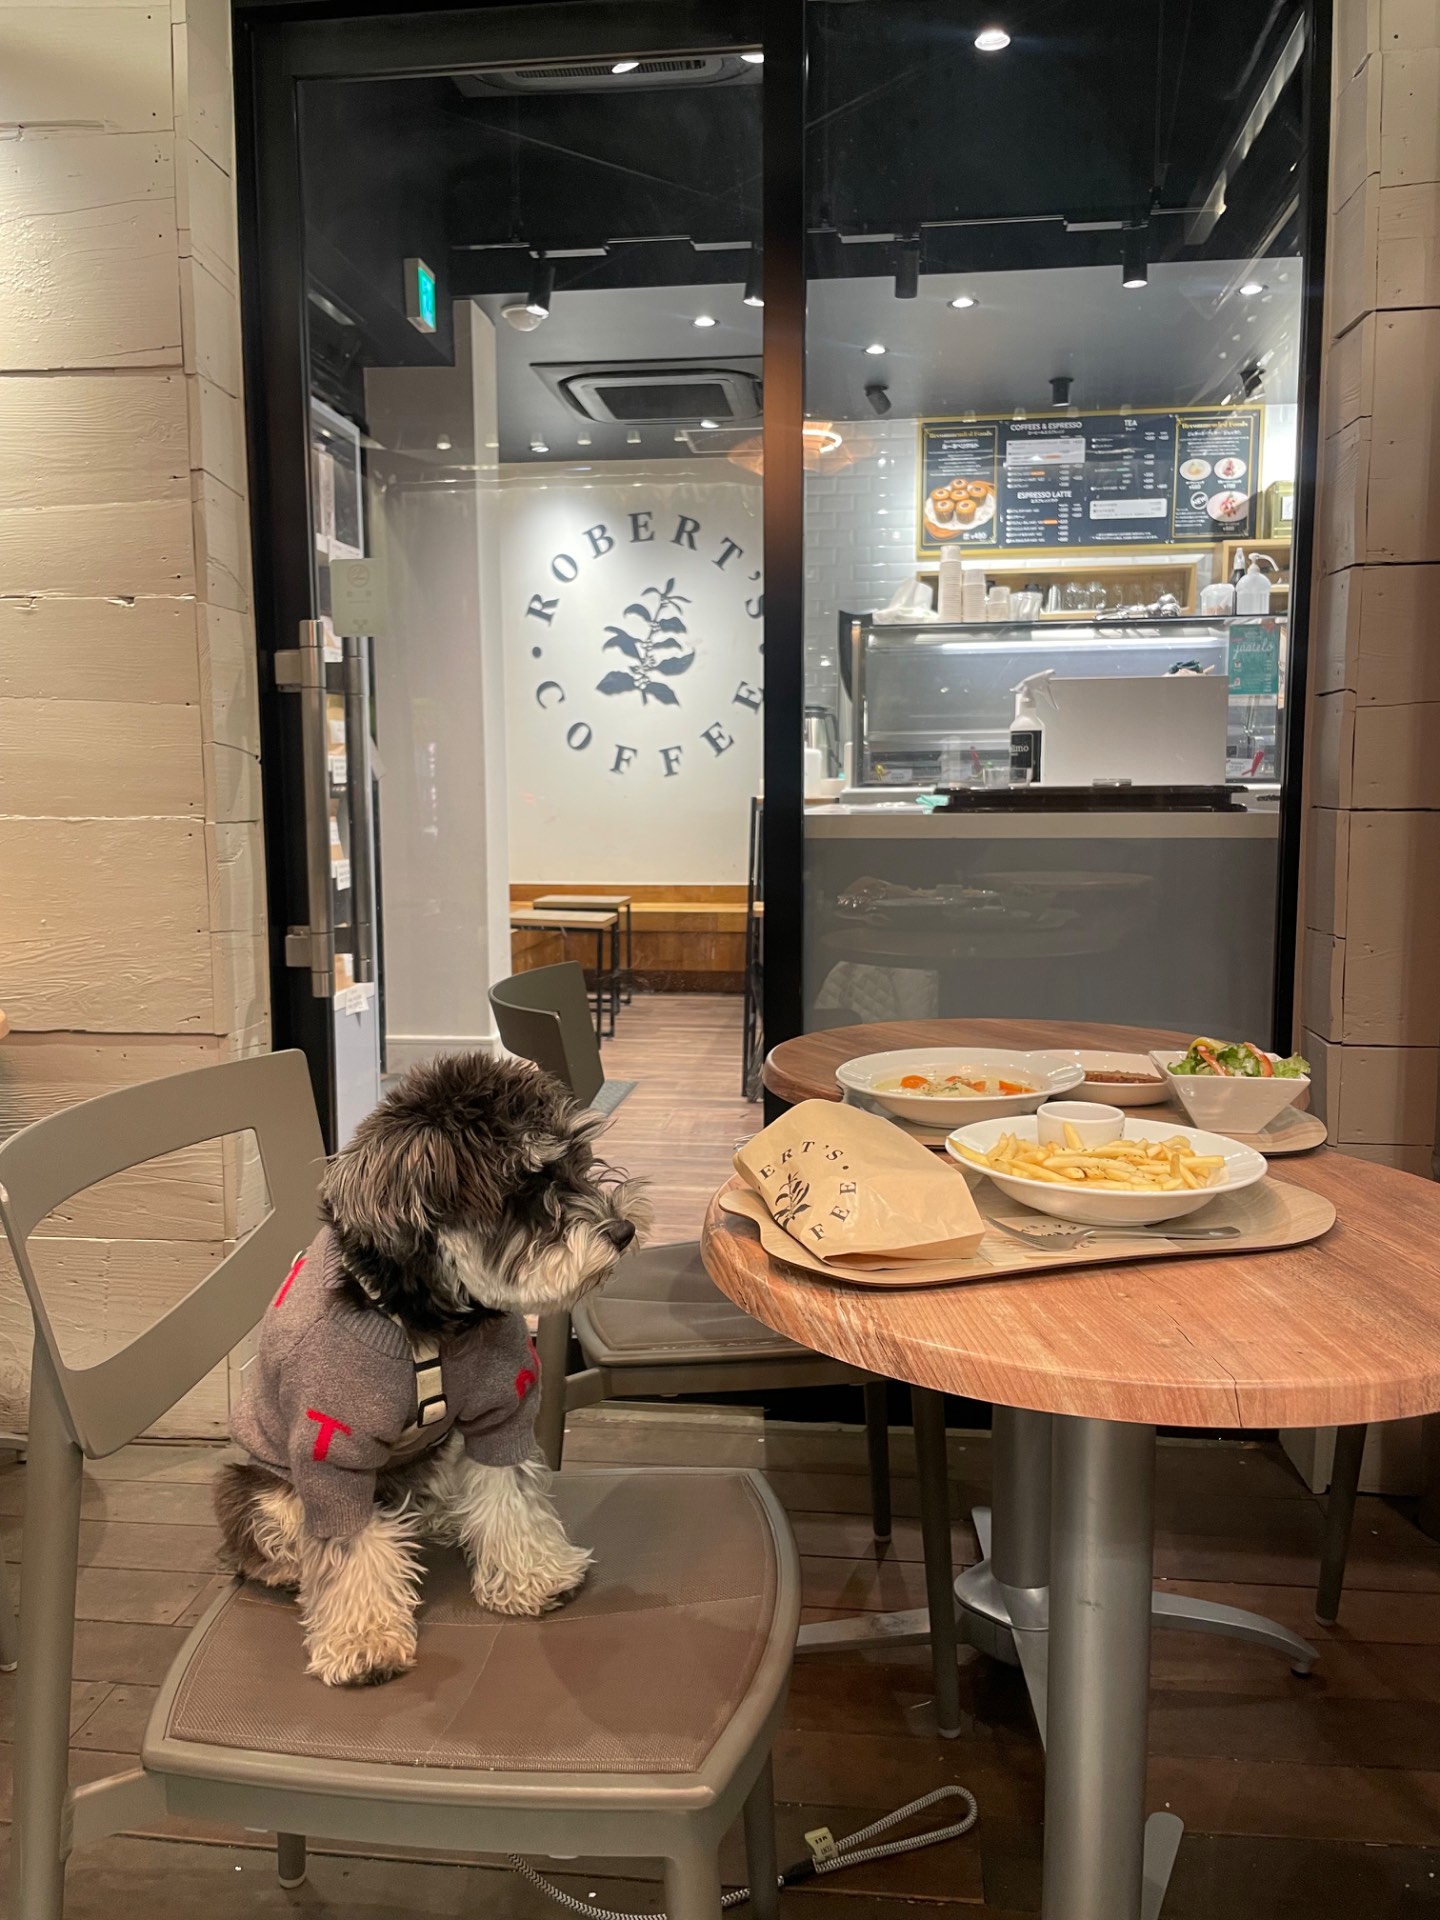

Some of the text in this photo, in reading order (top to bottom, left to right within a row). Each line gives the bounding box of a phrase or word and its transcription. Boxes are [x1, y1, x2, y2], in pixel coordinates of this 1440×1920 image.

[1048, 421, 1083, 430] ESPRESSO
[1124, 419, 1138, 427] TEA
[1017, 490, 1072, 499] ESPRESSO LATTE
[525, 511, 764, 627] ROBERT'S
[536, 680, 764, 778] COFFEE
[758, 1141, 844, 1181] ERT'S
[808, 1180, 857, 1242] FEE
